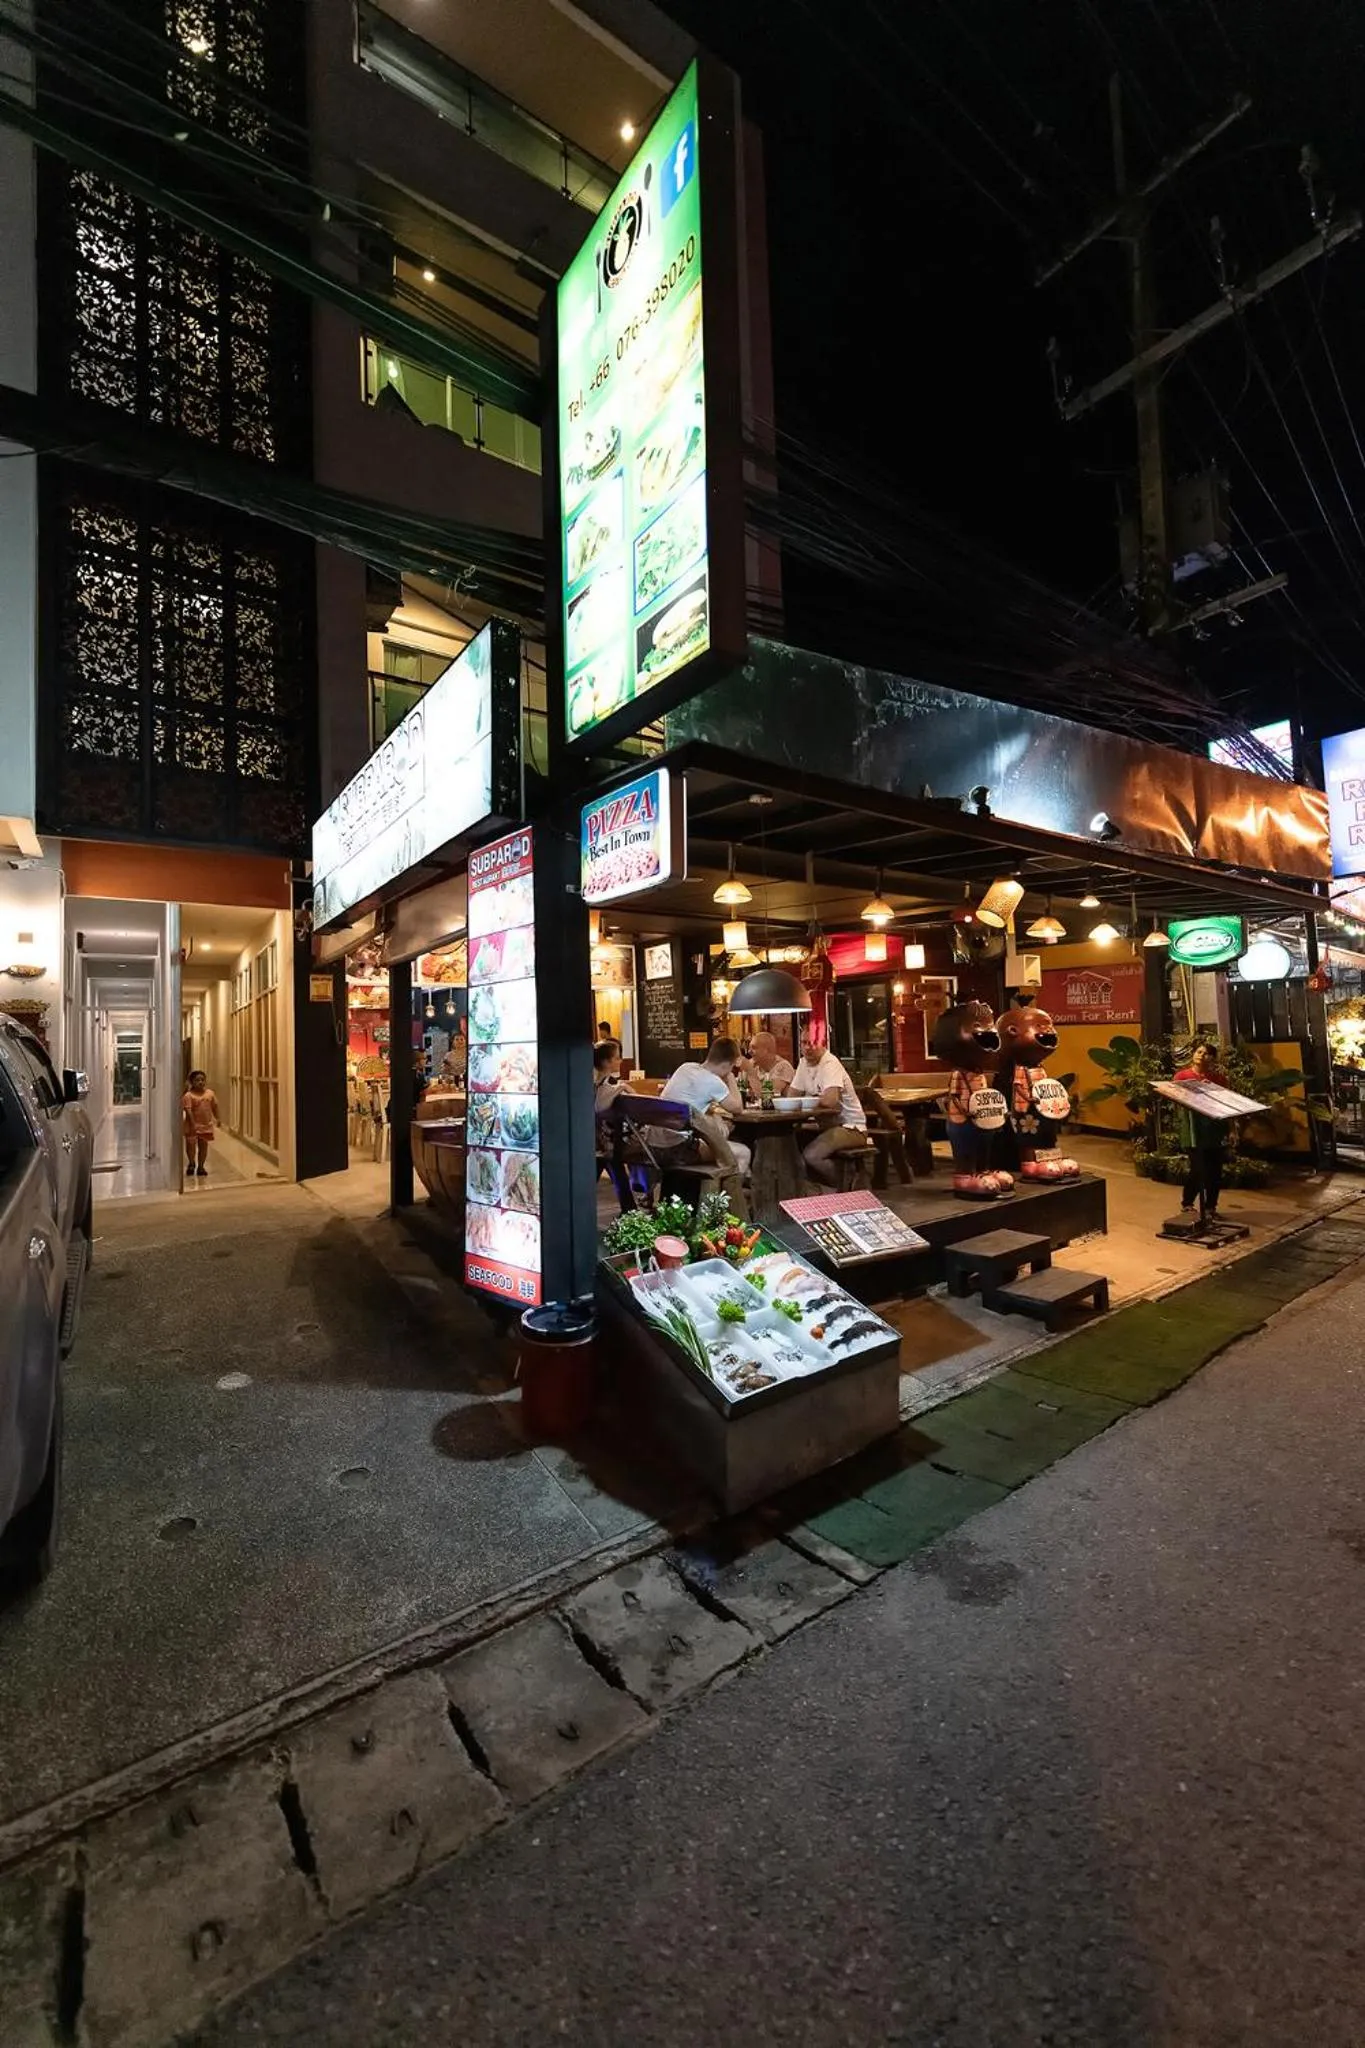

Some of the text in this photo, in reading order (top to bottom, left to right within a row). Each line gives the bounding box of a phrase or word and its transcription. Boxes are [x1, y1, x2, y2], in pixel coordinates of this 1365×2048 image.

[568, 390, 587, 423] Tel.
[589, 358, 610, 392] +66
[616, 234, 696, 361] 076-398020
[586, 787, 655, 844] PIZZA
[589, 828, 651, 862] Best In Town
[1081, 1011, 1100, 1021] For
[1106, 1009, 1135, 1020] Rent
[468, 1264, 513, 1290] SEAFOOD
